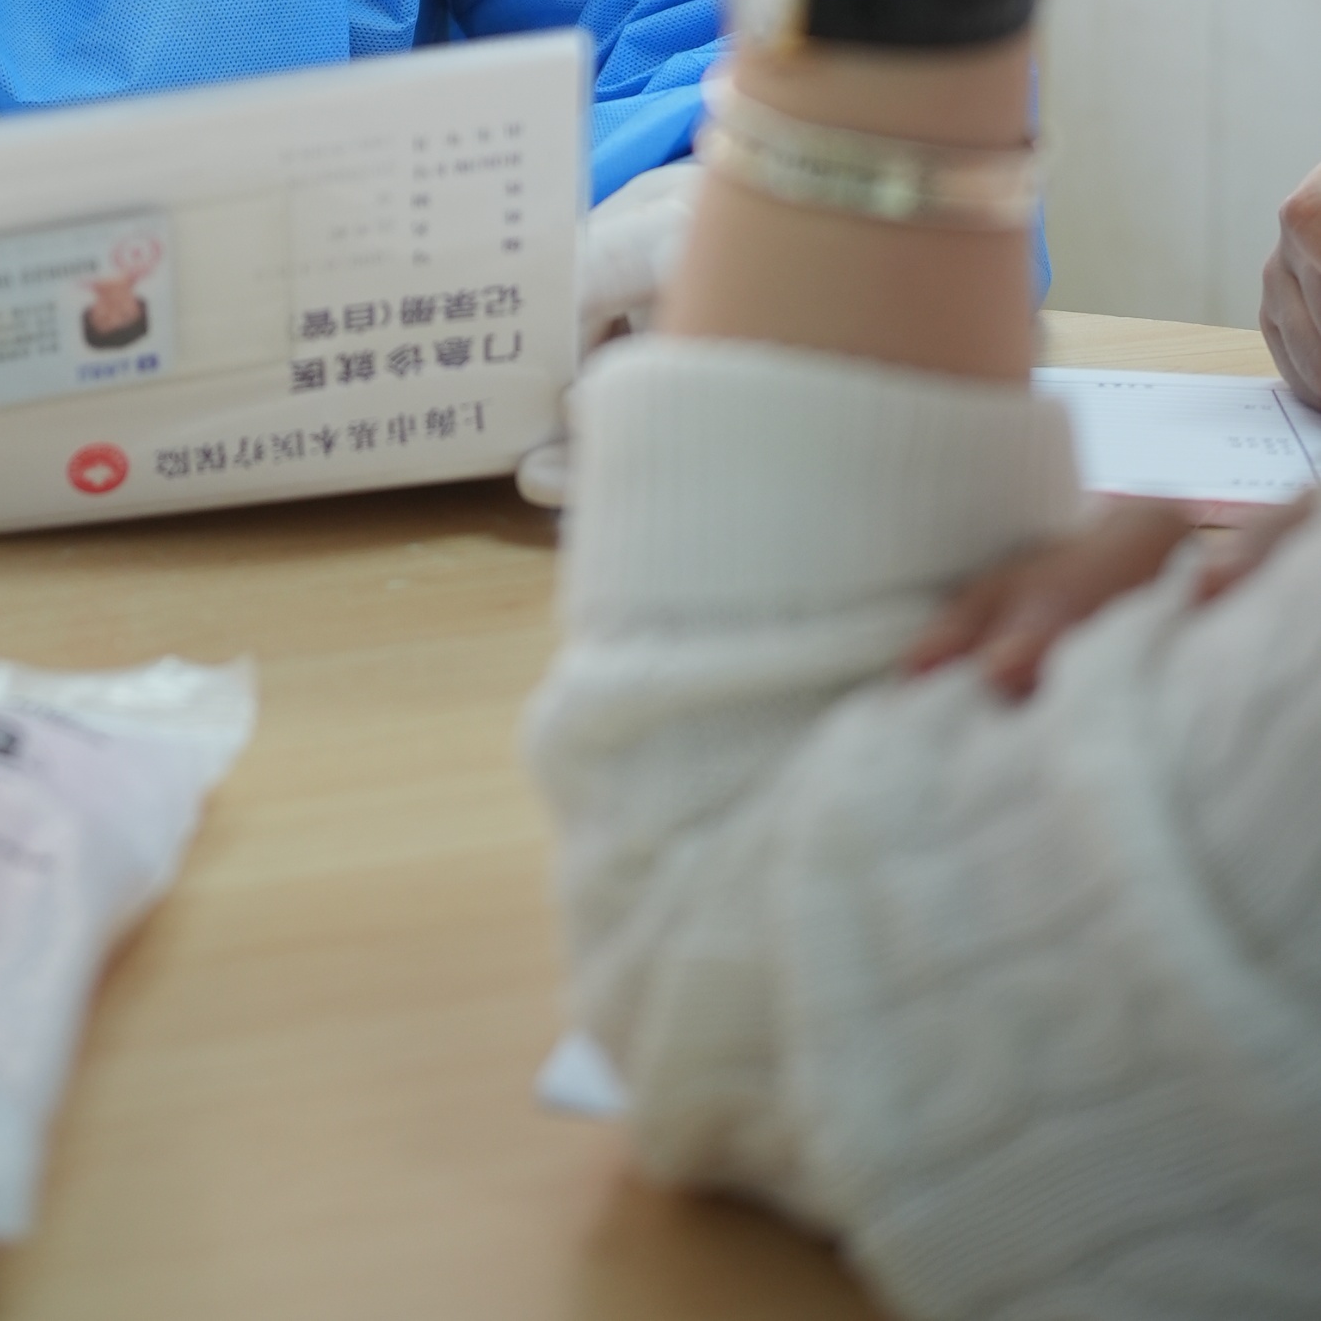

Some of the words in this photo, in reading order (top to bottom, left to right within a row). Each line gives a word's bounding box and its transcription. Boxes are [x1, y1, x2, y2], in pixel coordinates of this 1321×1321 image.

[290, 330, 522, 393] 门急诊就医
[155, 399, 490, 479] 上海市基本医疗保险
